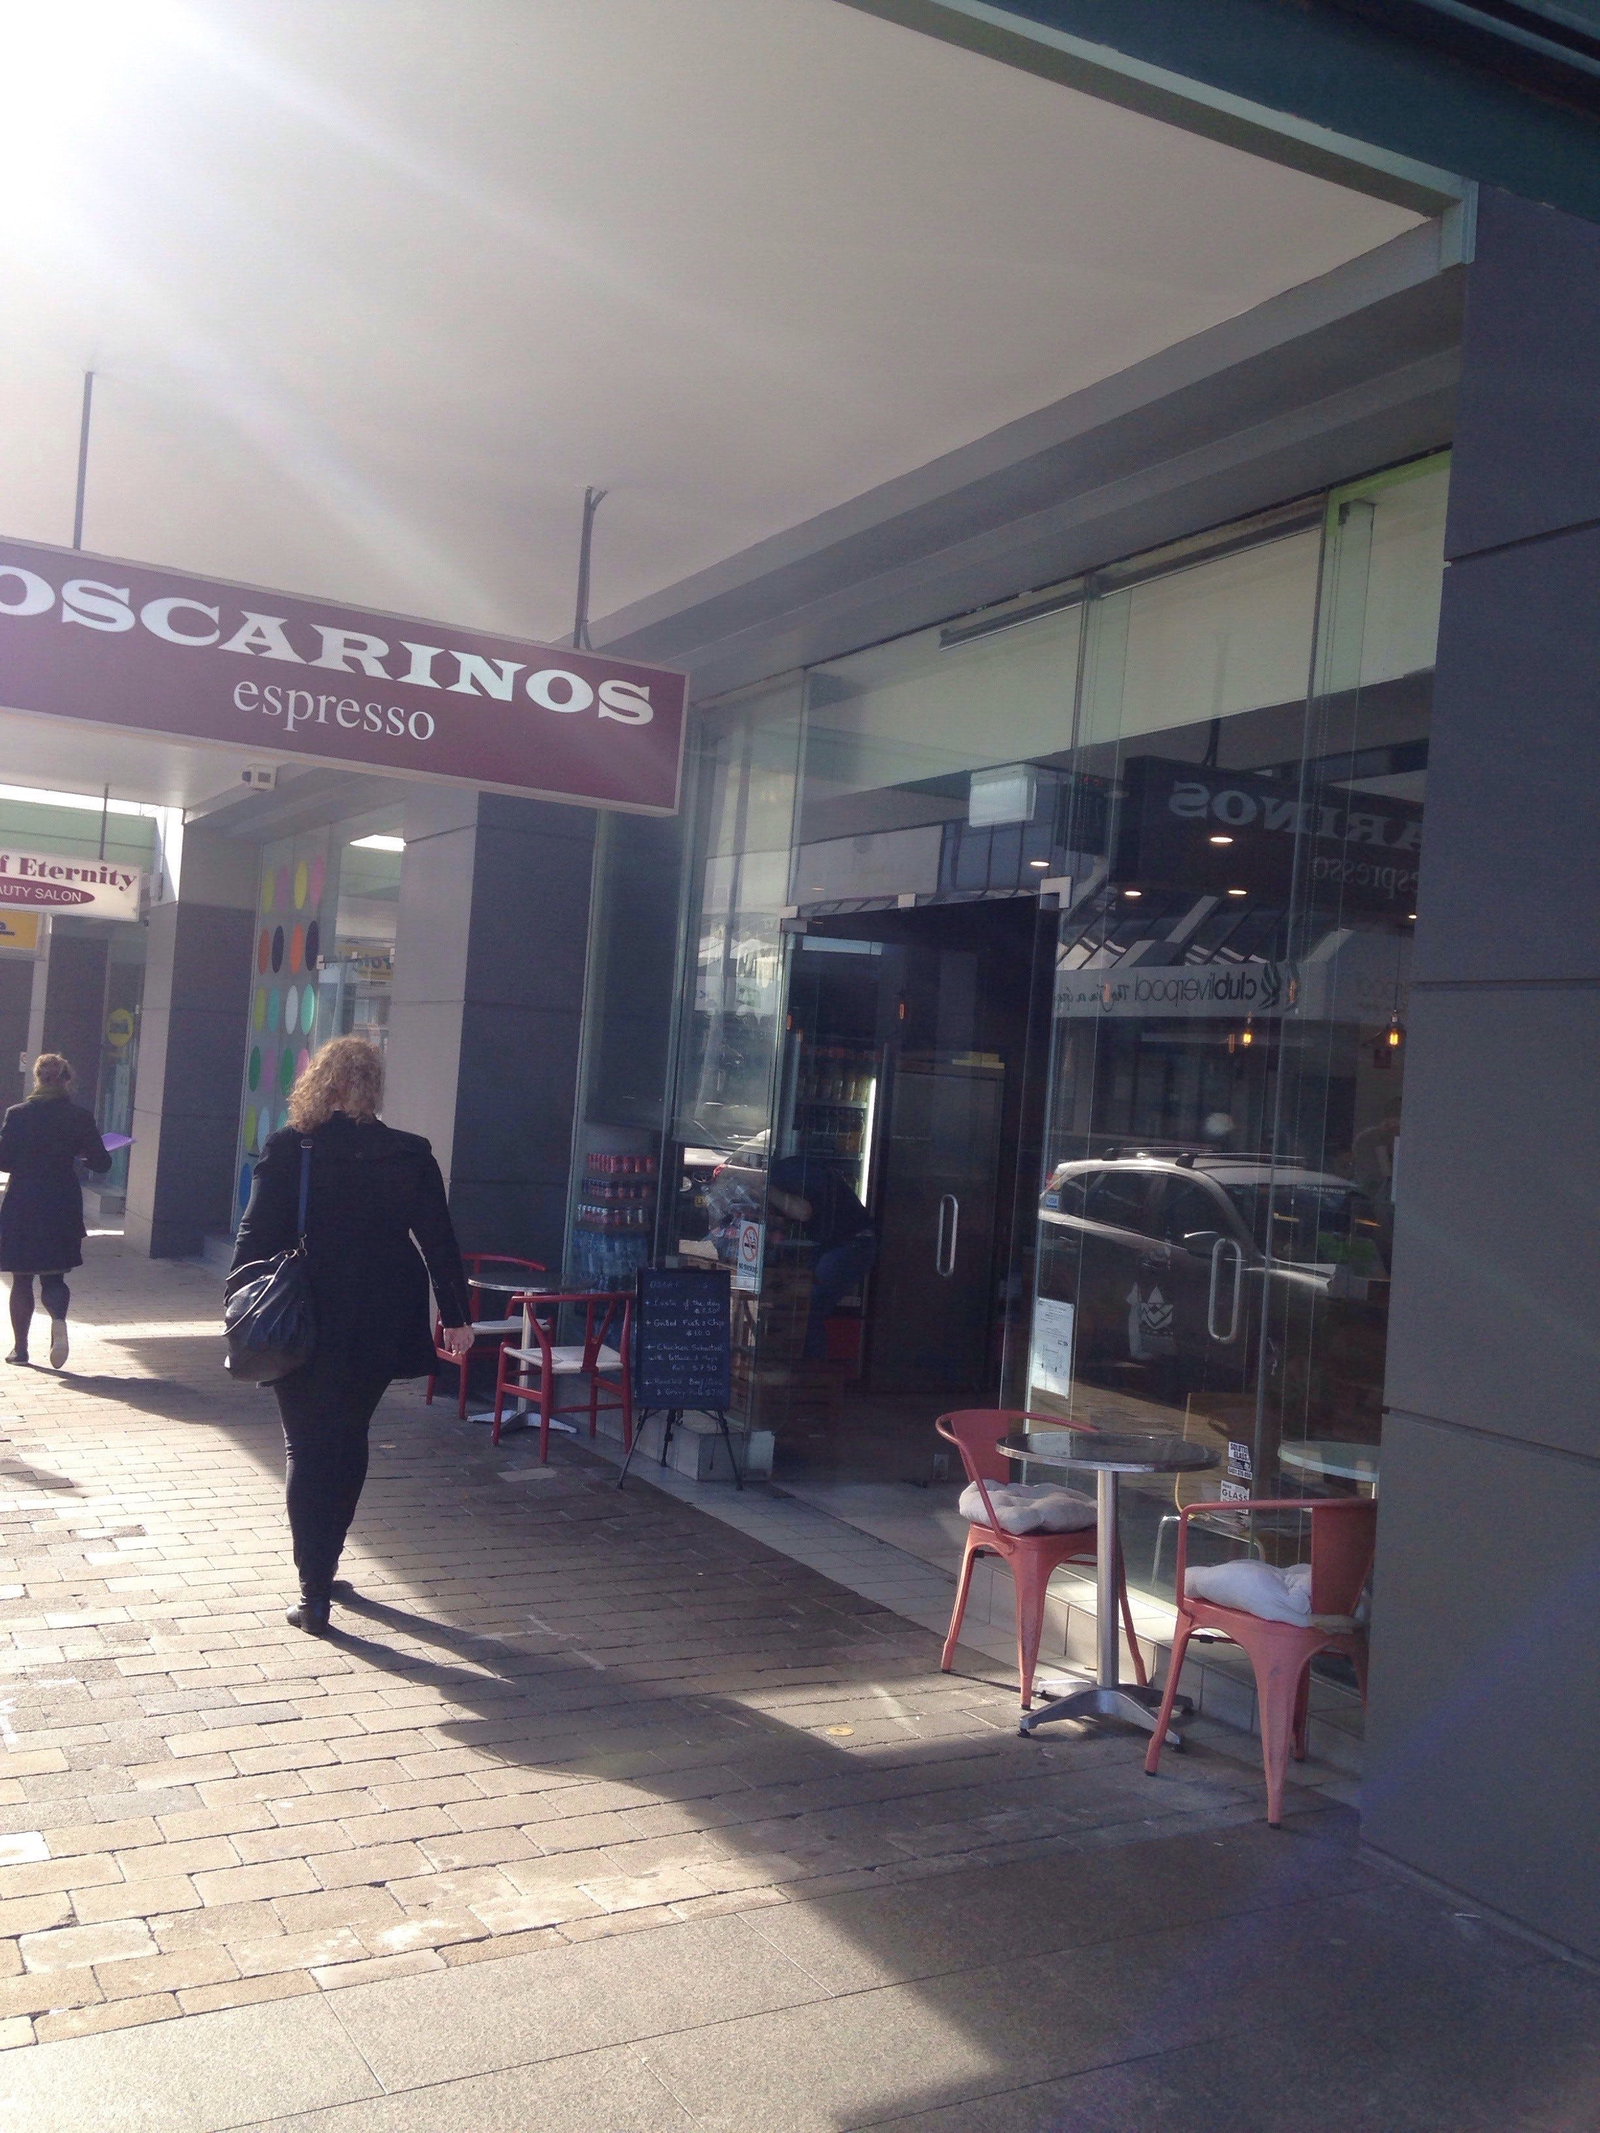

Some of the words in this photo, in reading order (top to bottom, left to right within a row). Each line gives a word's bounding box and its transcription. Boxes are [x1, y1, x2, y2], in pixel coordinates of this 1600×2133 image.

[0, 564, 654, 726] OSCARINOS
[233, 680, 435, 740] espresso
[19, 856, 137, 892] Eternity
[35, 887, 81, 902] SALON
[1221, 1488, 1248, 1502] GLASS
